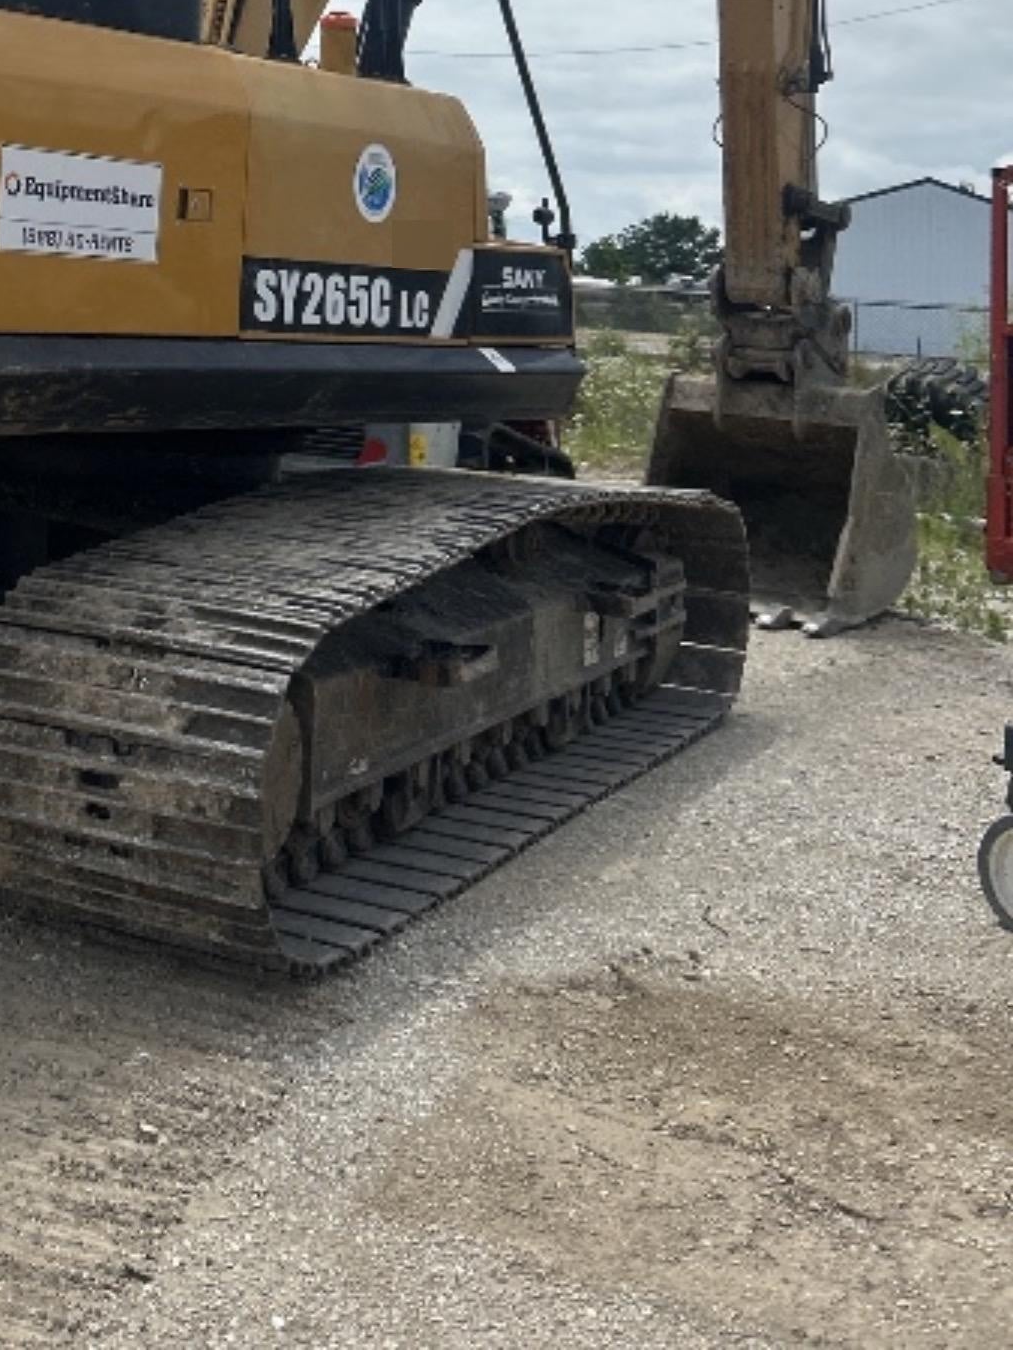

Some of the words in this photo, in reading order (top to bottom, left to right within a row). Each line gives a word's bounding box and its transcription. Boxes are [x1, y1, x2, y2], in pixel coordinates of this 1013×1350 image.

[25, 176, 154, 208] EquipmentShare
[501, 265, 547, 289] SANY
[253, 269, 391, 328] SY265C
[399, 290, 429, 328] LC
